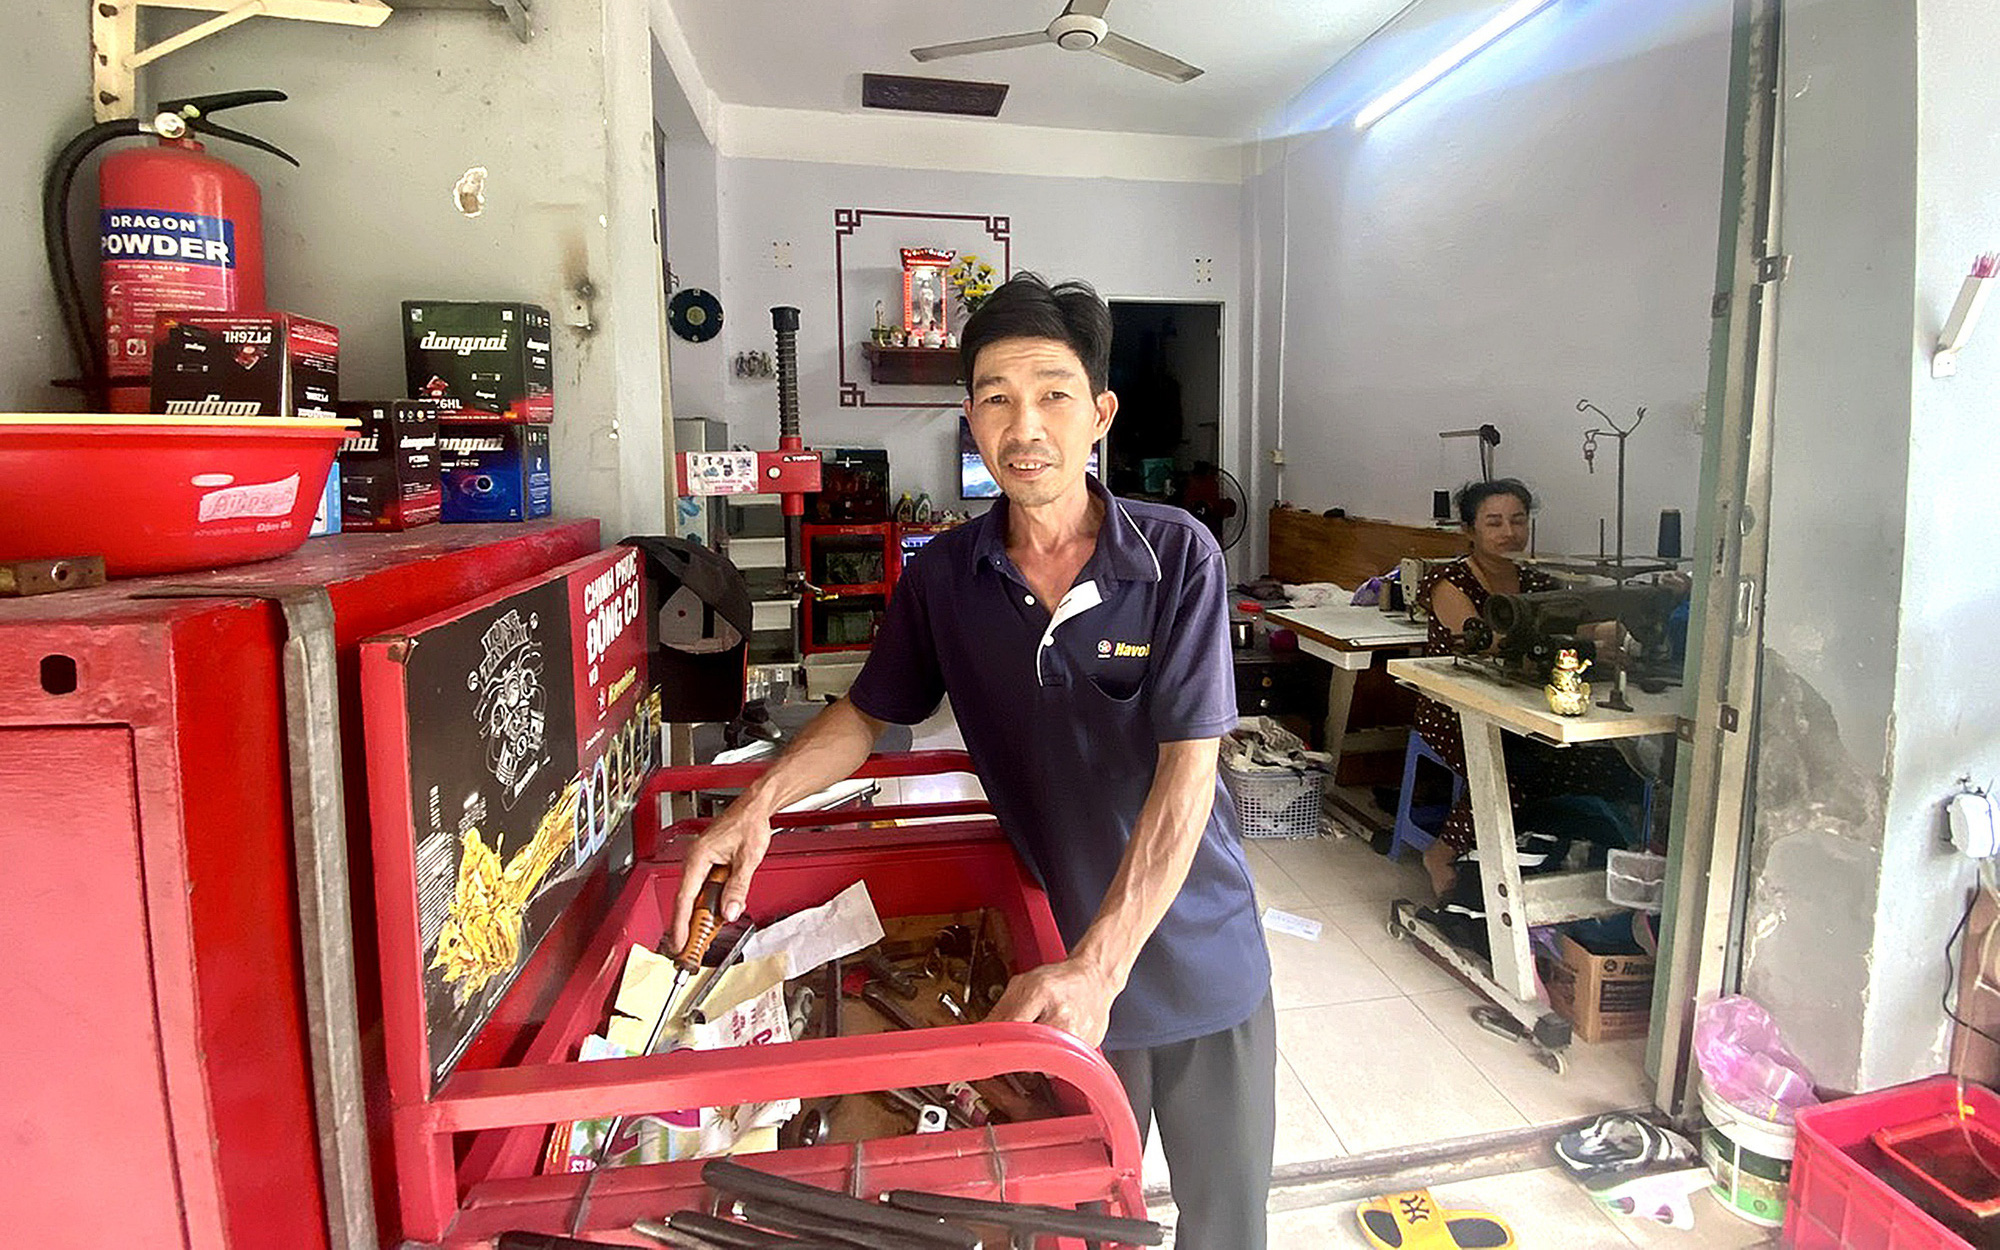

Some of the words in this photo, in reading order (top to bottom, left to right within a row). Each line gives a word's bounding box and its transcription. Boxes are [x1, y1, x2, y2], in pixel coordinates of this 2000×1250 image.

[110, 215, 196, 233] DRAGON
[222, 330, 272, 344] PTZ6HL
[420, 328, 508, 356] dongnai
[584, 566, 615, 616] CHINH
[586, 595, 623, 665] ĐỘNG
